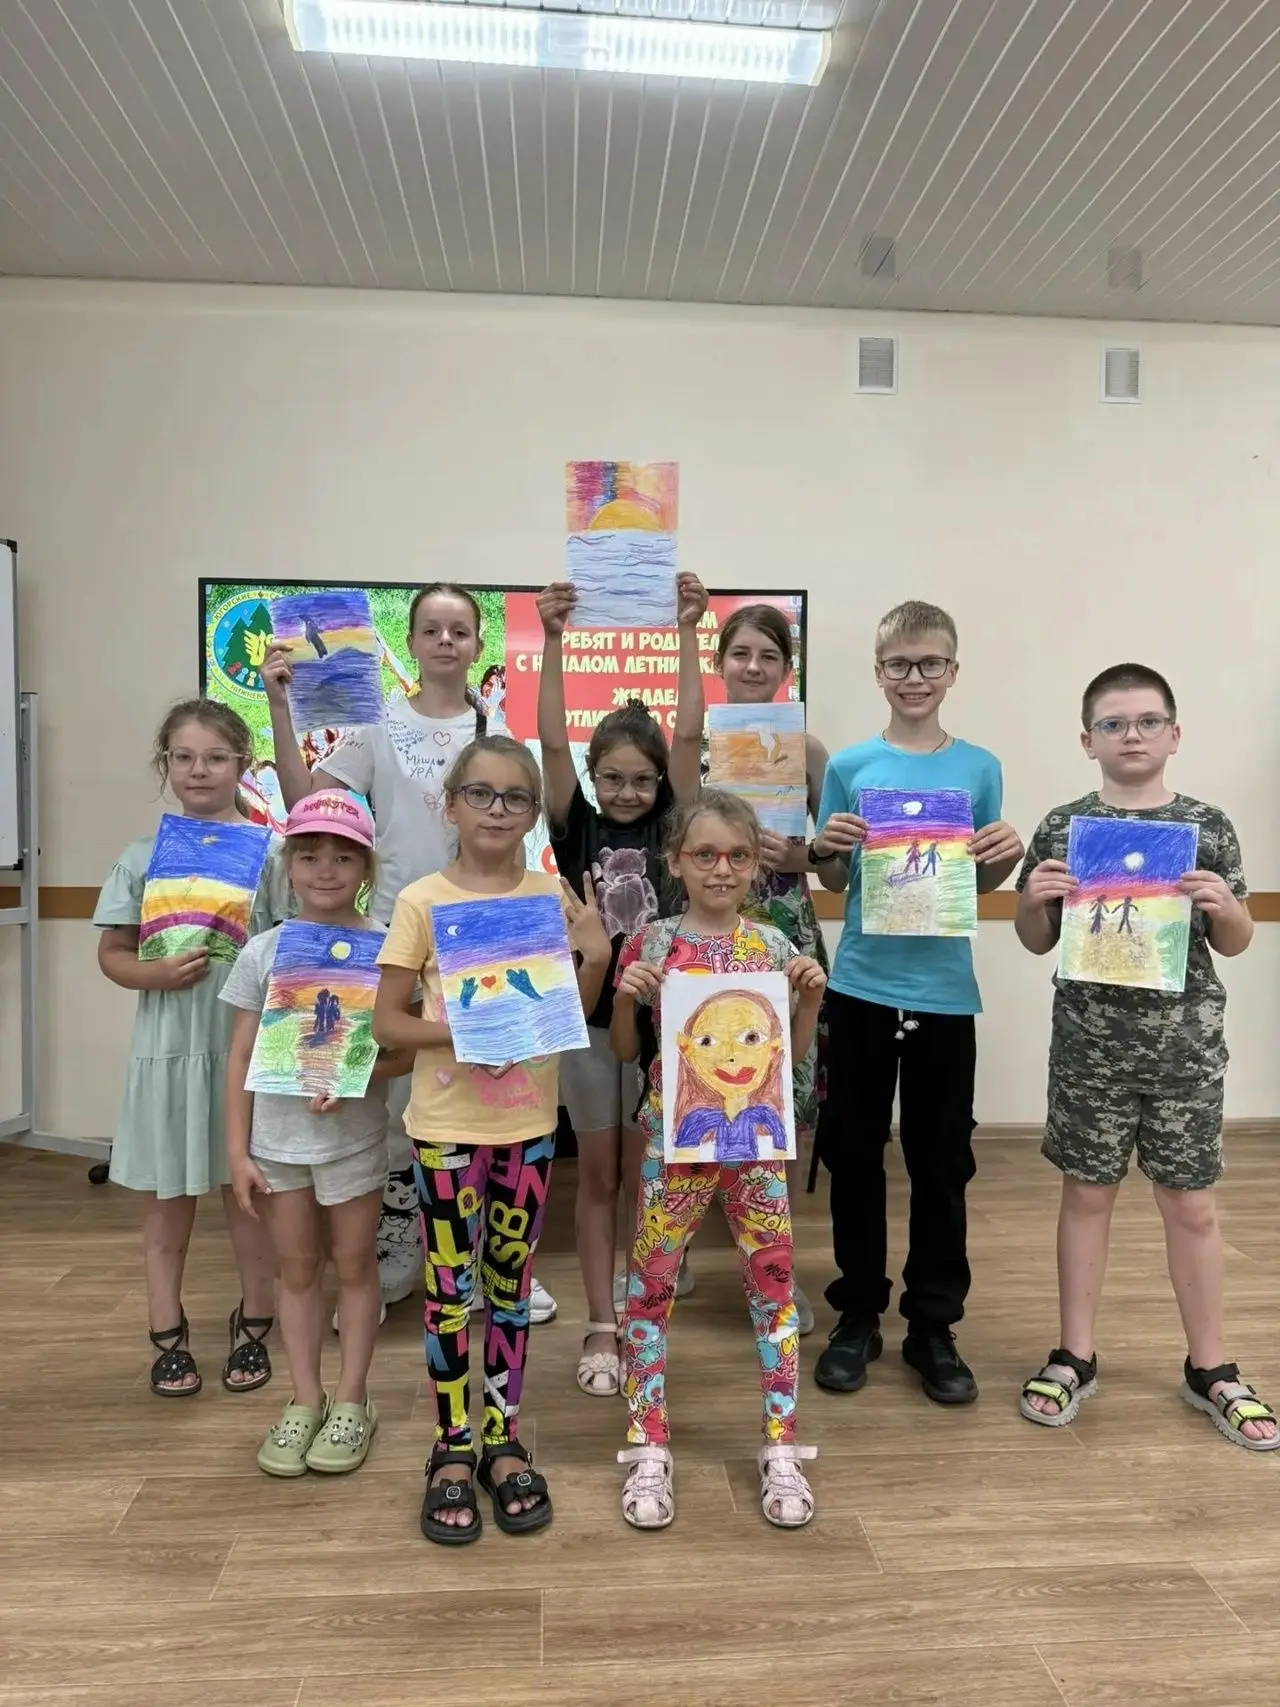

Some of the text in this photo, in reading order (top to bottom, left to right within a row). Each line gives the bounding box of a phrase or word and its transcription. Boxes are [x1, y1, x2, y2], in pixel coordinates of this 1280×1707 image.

[213, 593, 252, 621] ЮГОРСКИЕ
[621, 632, 635, 650] И
[516, 654, 528, 672] С
[410, 766, 435, 778] УРА
